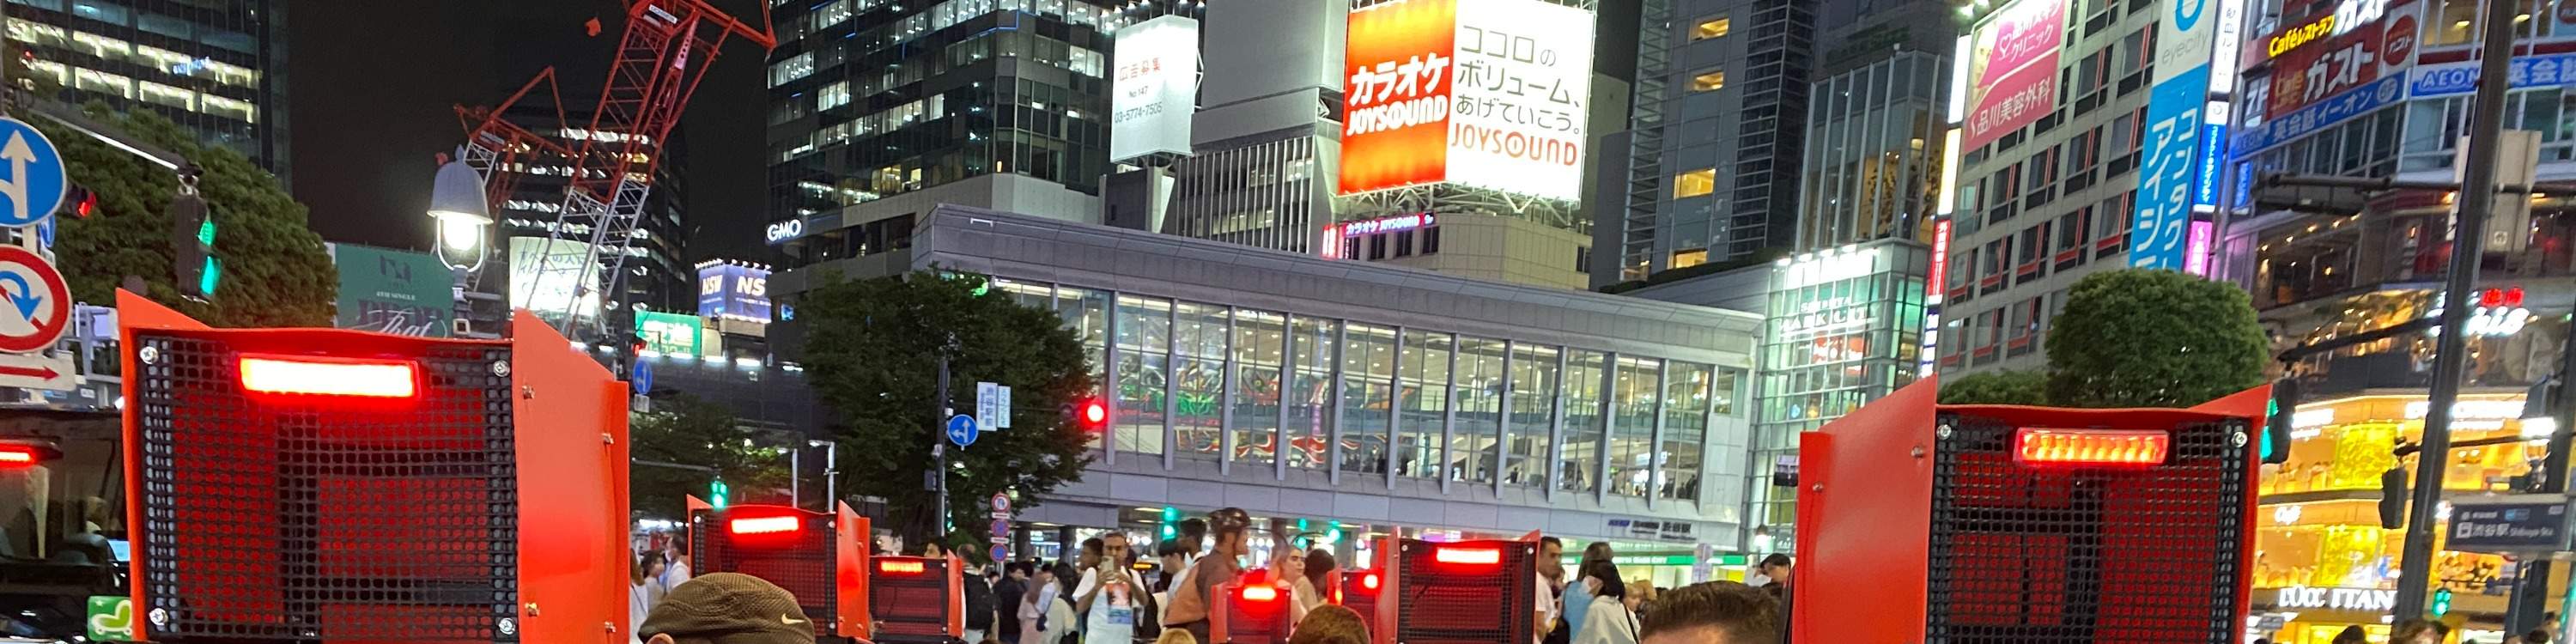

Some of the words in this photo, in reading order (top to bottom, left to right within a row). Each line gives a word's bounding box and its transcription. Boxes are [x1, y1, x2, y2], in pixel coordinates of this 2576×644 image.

[1460, 25, 1557, 67] ココロの
[2011, 23, 2053, 62] クリニック
[2162, 29, 2208, 67] eyecity
[1349, 52, 1450, 106] カラオケ
[1458, 59, 1580, 108] ボリューム、
[2304, 42, 2374, 104] ガスト
[2424, 68, 2481, 88] AEON
[1346, 94, 1449, 136] JOYSOUND
[1456, 94, 1580, 136] あげていこう。
[1977, 76, 2050, 136] 品川美容外科
[2273, 90, 2373, 142] 英会話イーオン
[1451, 123, 1578, 166] JOYSOUND
[2163, 107, 2198, 270] コンタク
[767, 219, 802, 241] GMO
[1346, 220, 1379, 234] カラオケ
[1379, 215, 1420, 231] JOYSOUND
[702, 275, 724, 296] NSW
[736, 276, 767, 297] NS
